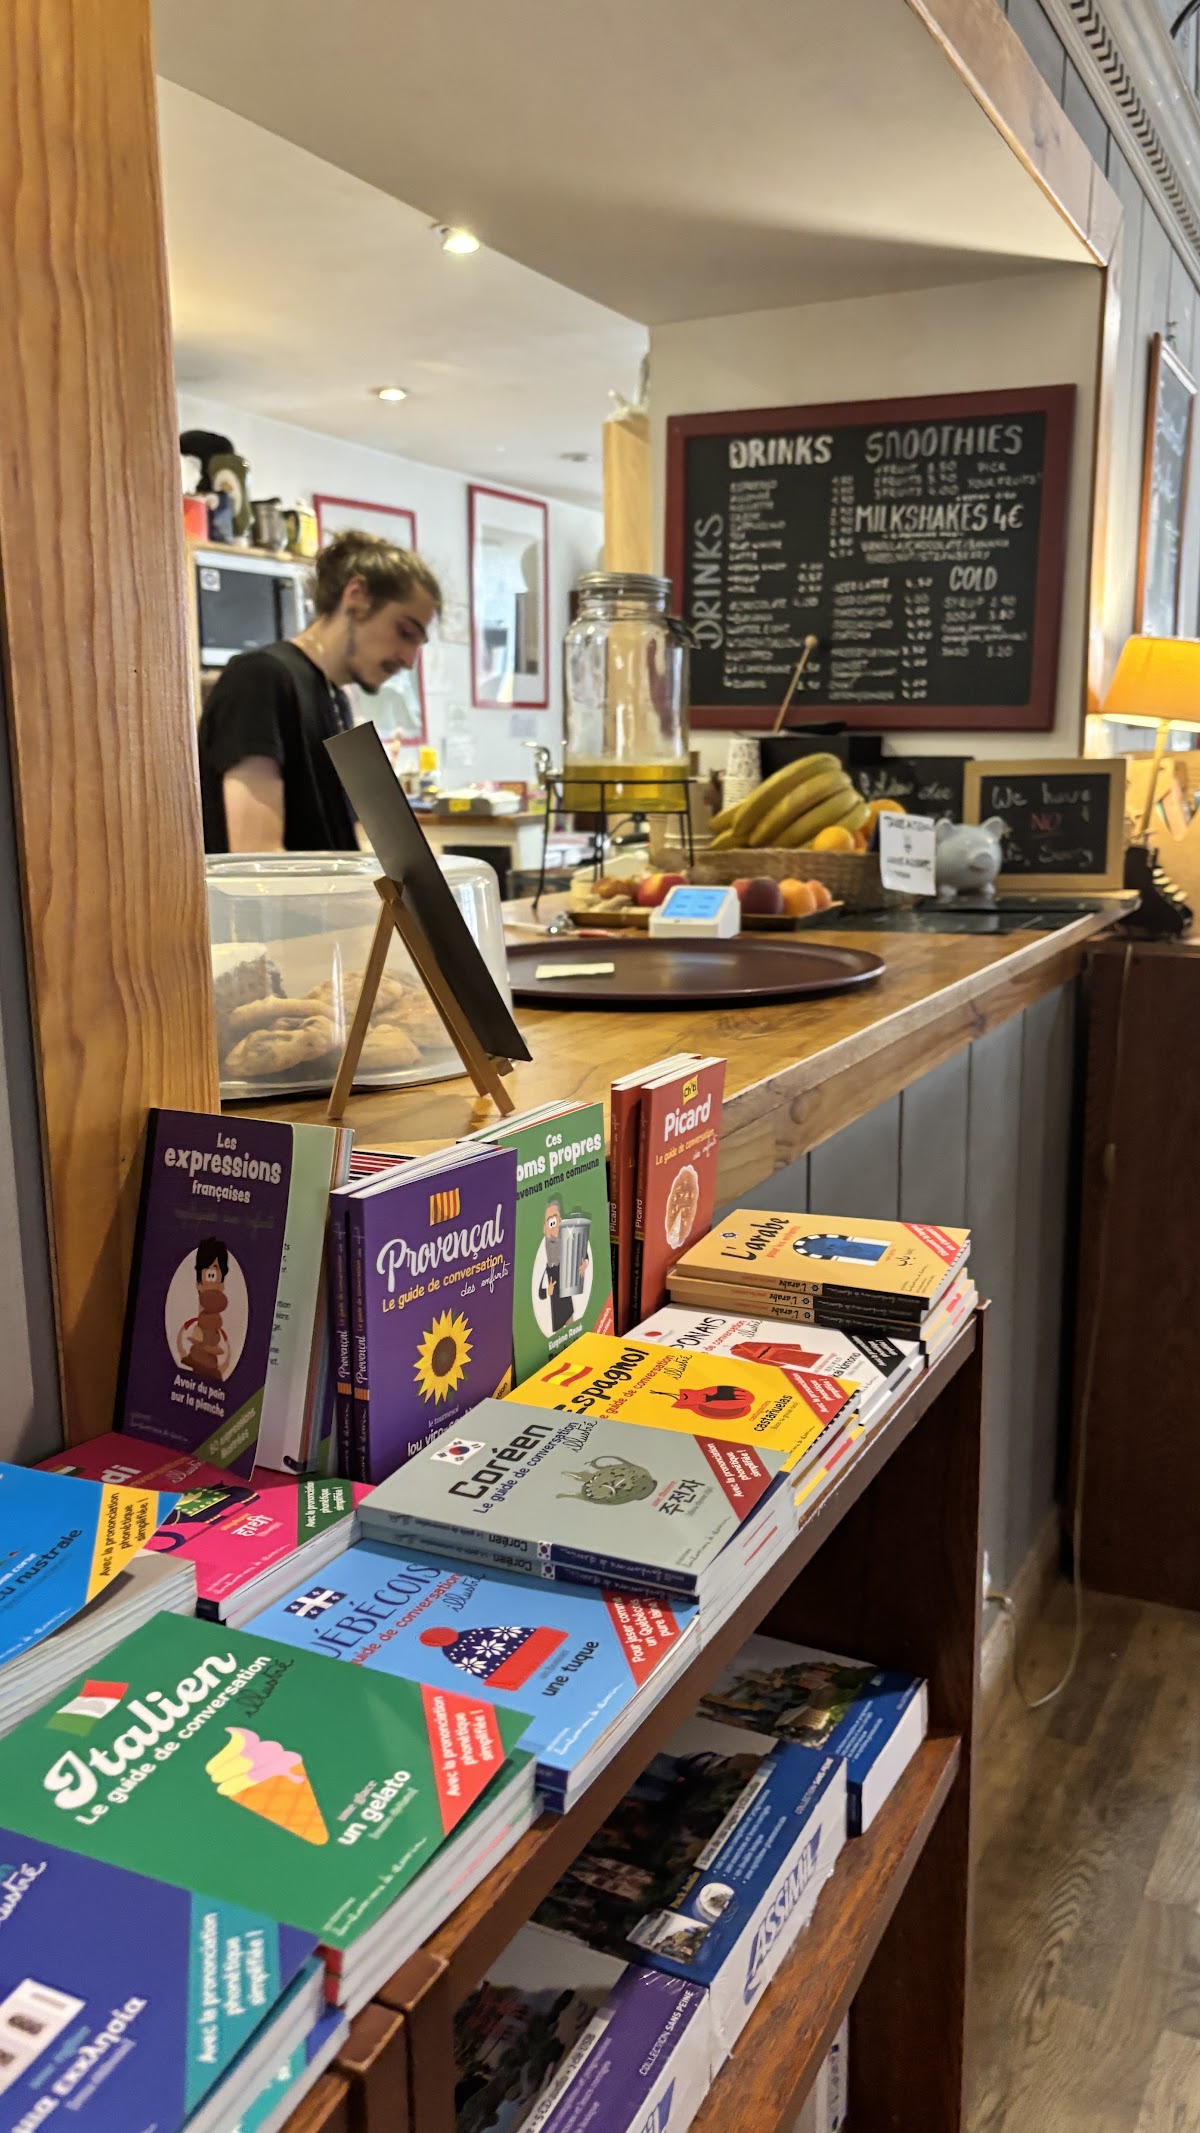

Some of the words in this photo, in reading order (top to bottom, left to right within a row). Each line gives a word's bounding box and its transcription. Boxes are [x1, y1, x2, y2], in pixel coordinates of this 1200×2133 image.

[728, 435, 834, 469] DRINKS
[855, 503, 988, 533] MILKSHAKES
[993, 504, 1024, 531] 4€
[692, 513, 724, 650] DRINKS
[949, 565, 998, 592] COLD
[991, 785, 1027, 810] We
[1031, 812, 1063, 832] NO
[664, 1093, 712, 1142] Picard
[217, 1132, 237, 1150] Les
[517, 1155, 546, 1182] oms
[548, 1133, 602, 1175] propres
[546, 1133, 562, 1148] Ces
[656, 1155, 664, 1166] Le
[664, 1147, 678, 1165] guide
[678, 1143, 685, 1153] de
[165, 1147, 282, 1184] expressions
[516, 1182, 543, 1200] evenus
[544, 1173, 565, 1189] noms
[566, 1158, 600, 1179] communs
[192, 1179, 251, 1204] françaises
[610, 1202, 618, 1232] Picard
[376, 1204, 504, 1292] Provençal
[721, 1217, 790, 1261] L'arabe
[382, 1299, 396, 1313] Le
[398, 1285, 425, 1310] guide
[427, 1278, 440, 1292] de
[443, 1254, 503, 1286] conversation
[460, 1282, 475, 1297] des
[481, 1261, 511, 1293] enfants
[778, 1279, 809, 1293] L'arabe
[769, 1292, 798, 1306] L'arabe
[771, 1306, 800, 1320] L'arabe
[668, 1316, 727, 1350] PONAIS
[714, 1319, 748, 1348] conversation
[338, 1330, 350, 1379] Provençal
[355, 1335, 367, 1384] Provençal
[174, 1374, 197, 1391] Avoir
[198, 1383, 208, 1395] du
[209, 1387, 226, 1401] pain
[606, 1397, 628, 1414] guide
[624, 1389, 637, 1397] de
[633, 1354, 675, 1390] conversation
[171, 1391, 185, 1403] sur
[186, 1393, 194, 1405] la
[195, 1398, 225, 1418] planche
[754, 1395, 793, 1432] castañuelas
[407, 1439, 423, 1457] lou
[563, 1420, 598, 1453] illustré
[448, 1424, 554, 1500] Coréen
[473, 1502, 493, 1514] Le
[491, 1479, 518, 1502] guide
[513, 1467, 530, 1478] de
[526, 1422, 580, 1467] conversation
[707, 1442, 734, 1479] prononciation
[658, 1479, 706, 1516] 주전자
[730, 1483, 745, 1498] Avec
[105, 1492, 120, 1550] prononciation
[120, 1504, 134, 1550] phonétique
[136, 1502, 149, 1542] simplifiée
[305, 1517, 316, 1528] Avec
[15, 1529, 82, 1584] nustrale
[104, 1549, 113, 1559] la
[488, 1535, 528, 1553] Coréen
[492, 1553, 532, 1571] Coréen
[99, 1560, 112, 1577] Avec
[311, 1563, 441, 1659] UÉBÉCOIS
[443, 1573, 486, 1613] illustré
[612, 1596, 630, 1624] comme
[350, 1643, 382, 1667] uide
[379, 1628, 398, 1642] de
[396, 1573, 464, 1628] conversation
[623, 1622, 643, 1646] jaser
[655, 1619, 674, 1637] pure
[632, 1644, 646, 1663] Pour
[646, 1635, 657, 1647] un
[542, 1675, 569, 1697] une
[561, 1641, 600, 1672] tuque
[43, 1652, 238, 1810] Italien
[75, 1803, 109, 1825] Le
[107, 1761, 157, 1804] guide
[154, 1741, 181, 1761] de
[177, 1655, 272, 1740] conversation
[433, 1695, 458, 1759] prononciation
[455, 1711, 480, 1766] phonétique
[473, 1713, 495, 1762] simplifiée
[443, 1759, 457, 1770] la
[446, 1769, 461, 1797] Avec
[338, 1821, 368, 1845] un
[360, 1770, 412, 1823] gelato
[0, 1862, 48, 1921] ustré
[639, 2030, 671, 2076] COLLECTION
[665, 2010, 683, 2032] SANS
[676, 1989, 694, 2012] PEINE
